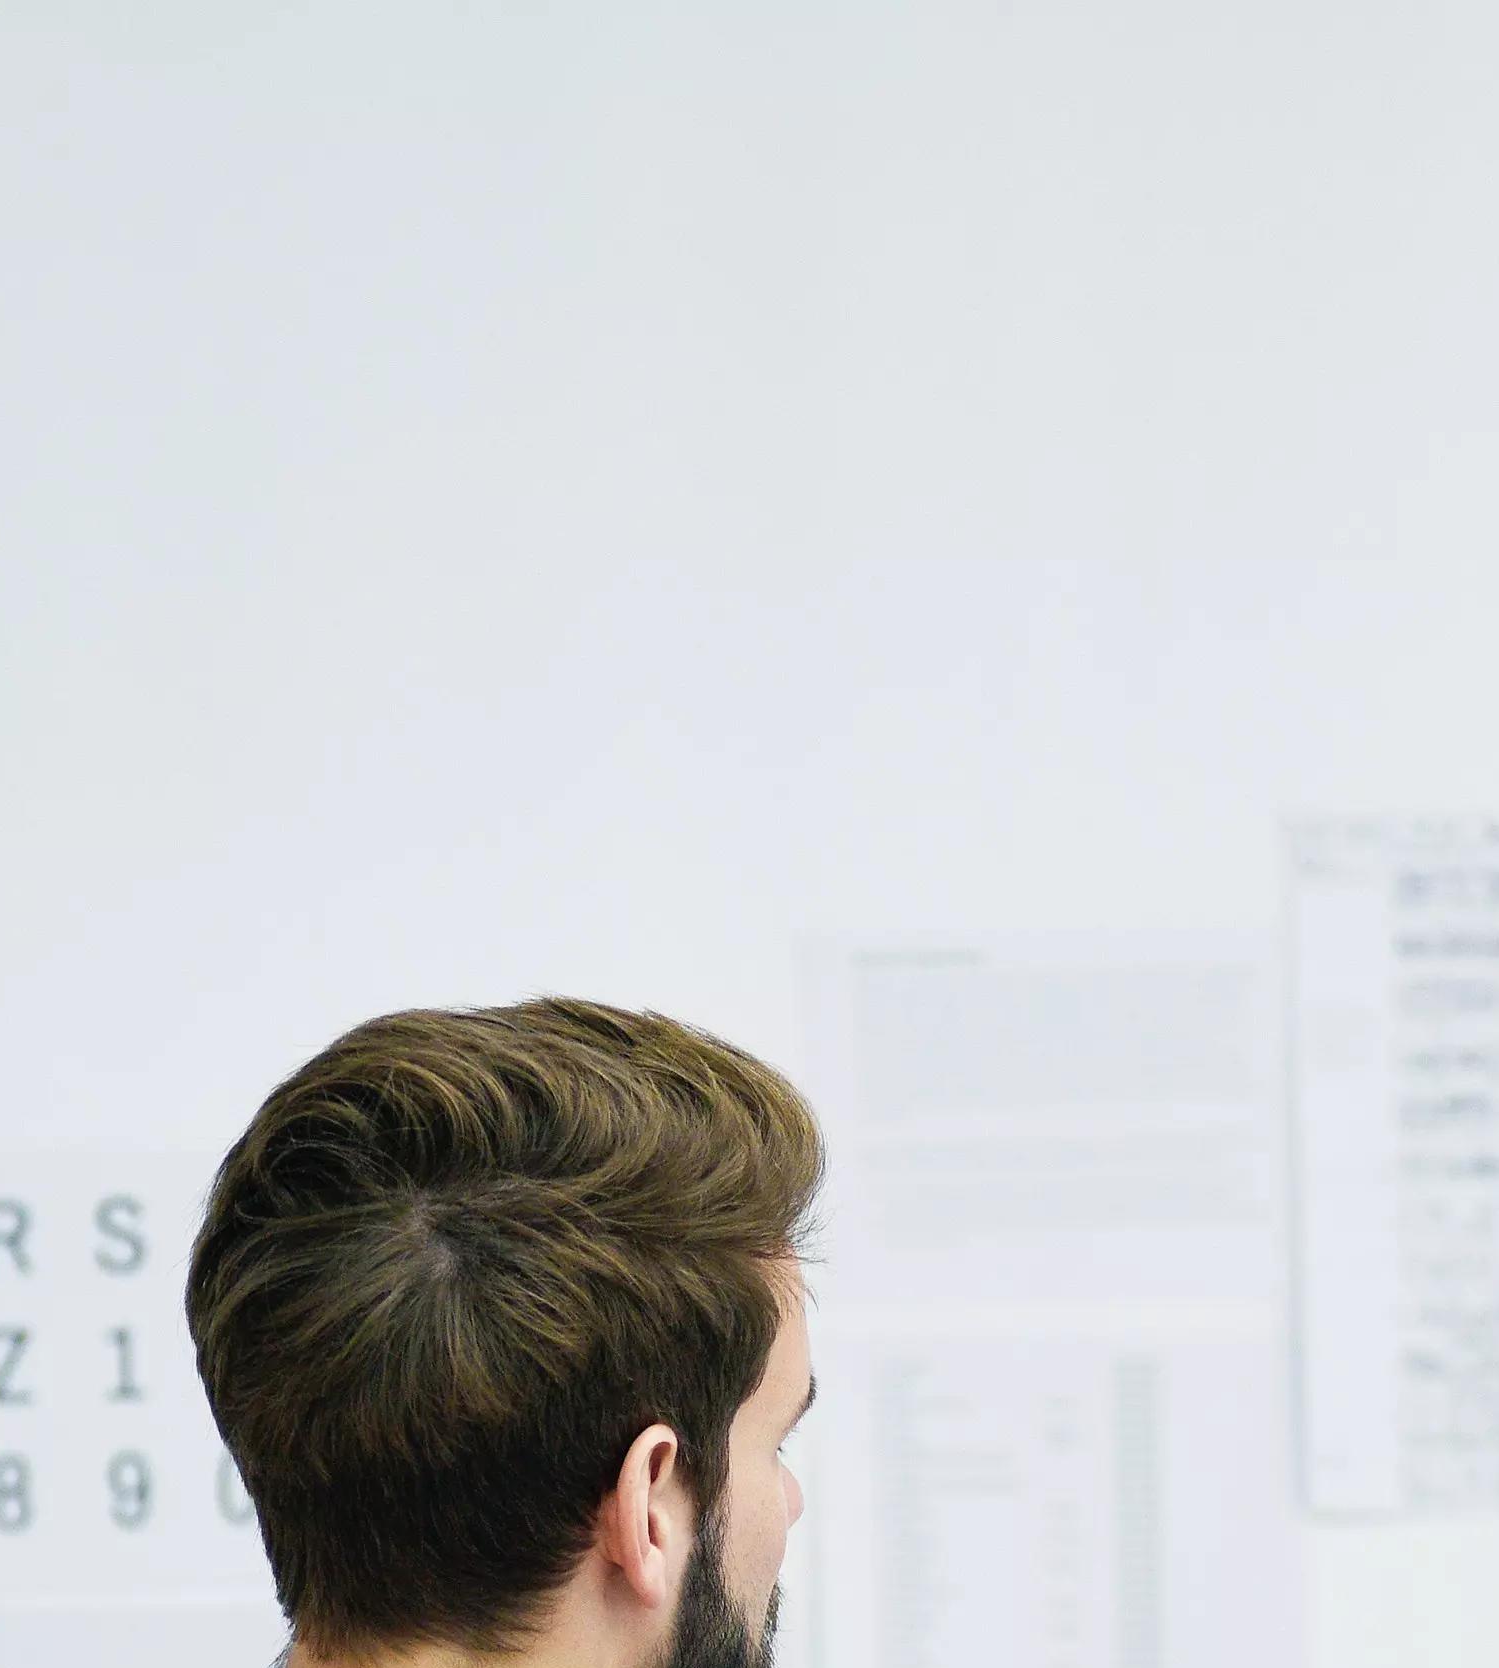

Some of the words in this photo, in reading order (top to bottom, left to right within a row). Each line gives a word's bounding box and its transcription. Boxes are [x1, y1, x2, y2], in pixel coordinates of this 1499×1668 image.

[95, 1195, 147, 1276] S
[103, 1325, 143, 1402] 1
[105, 1447, 153, 1532] 9
